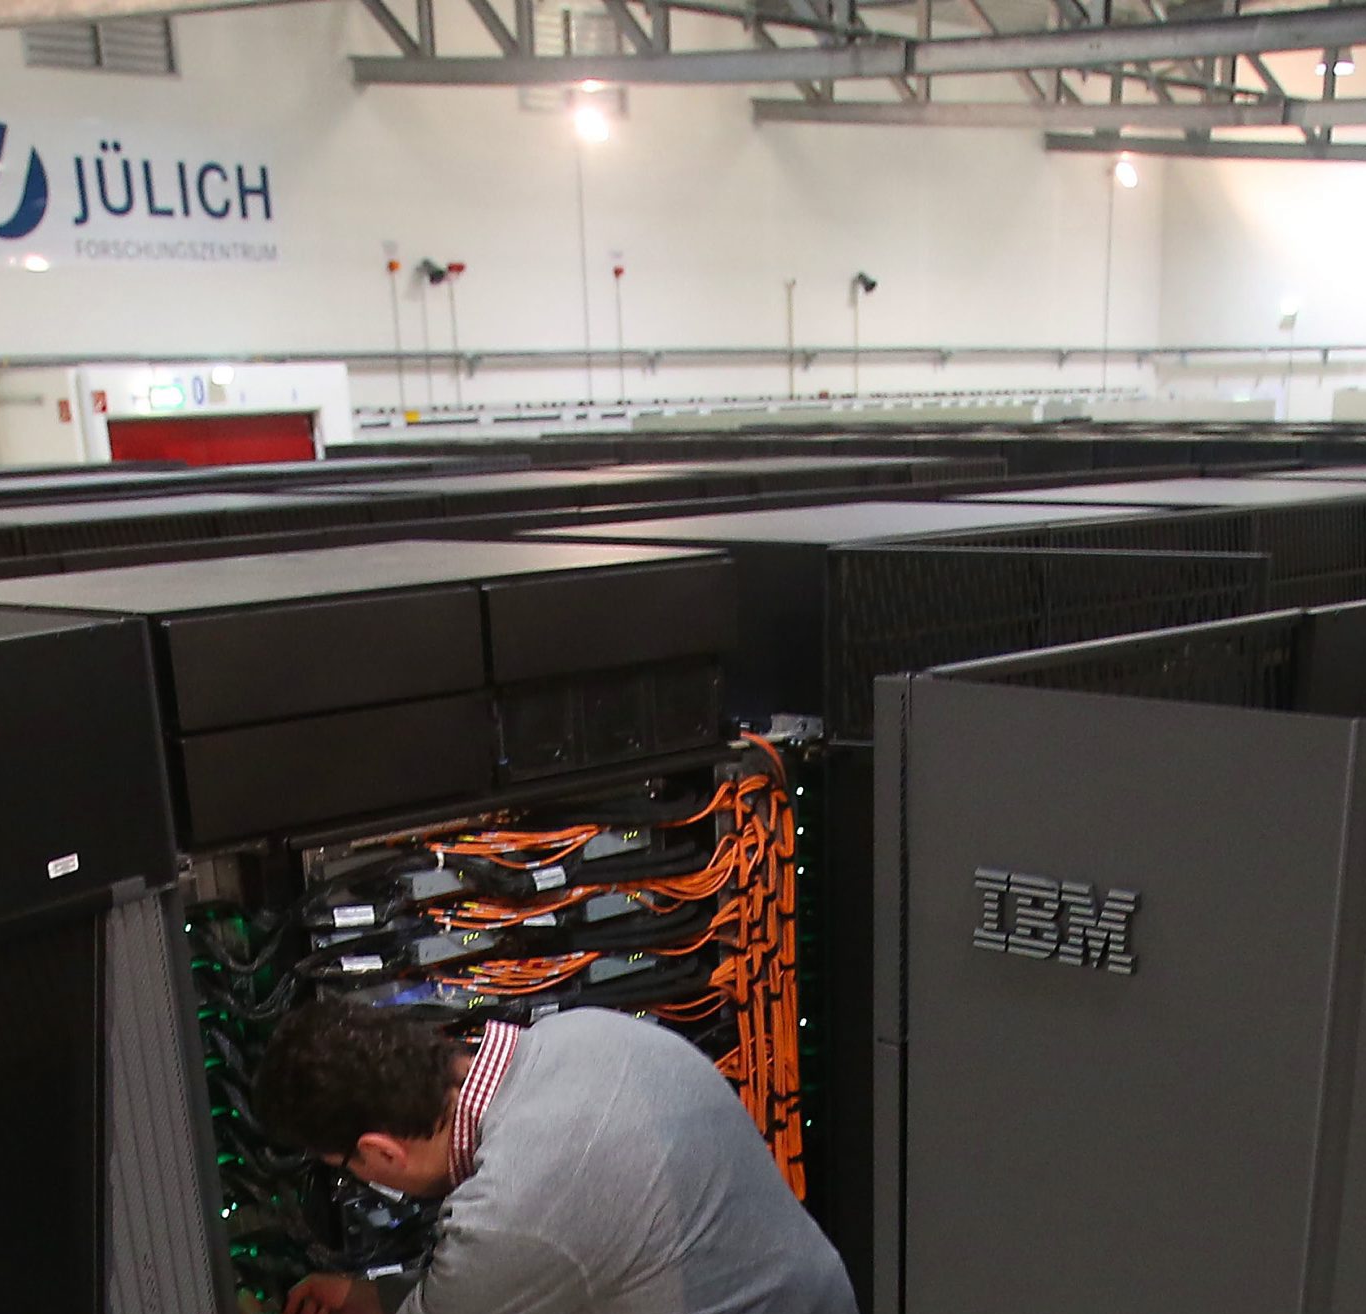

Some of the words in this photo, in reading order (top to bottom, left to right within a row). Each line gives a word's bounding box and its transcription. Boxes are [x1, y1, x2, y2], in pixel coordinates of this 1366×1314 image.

[73, 141, 273, 226] JÜLICH
[75, 239, 278, 262] FORSCHUNGSZENTRUM
[973, 866, 1139, 975] IBM
